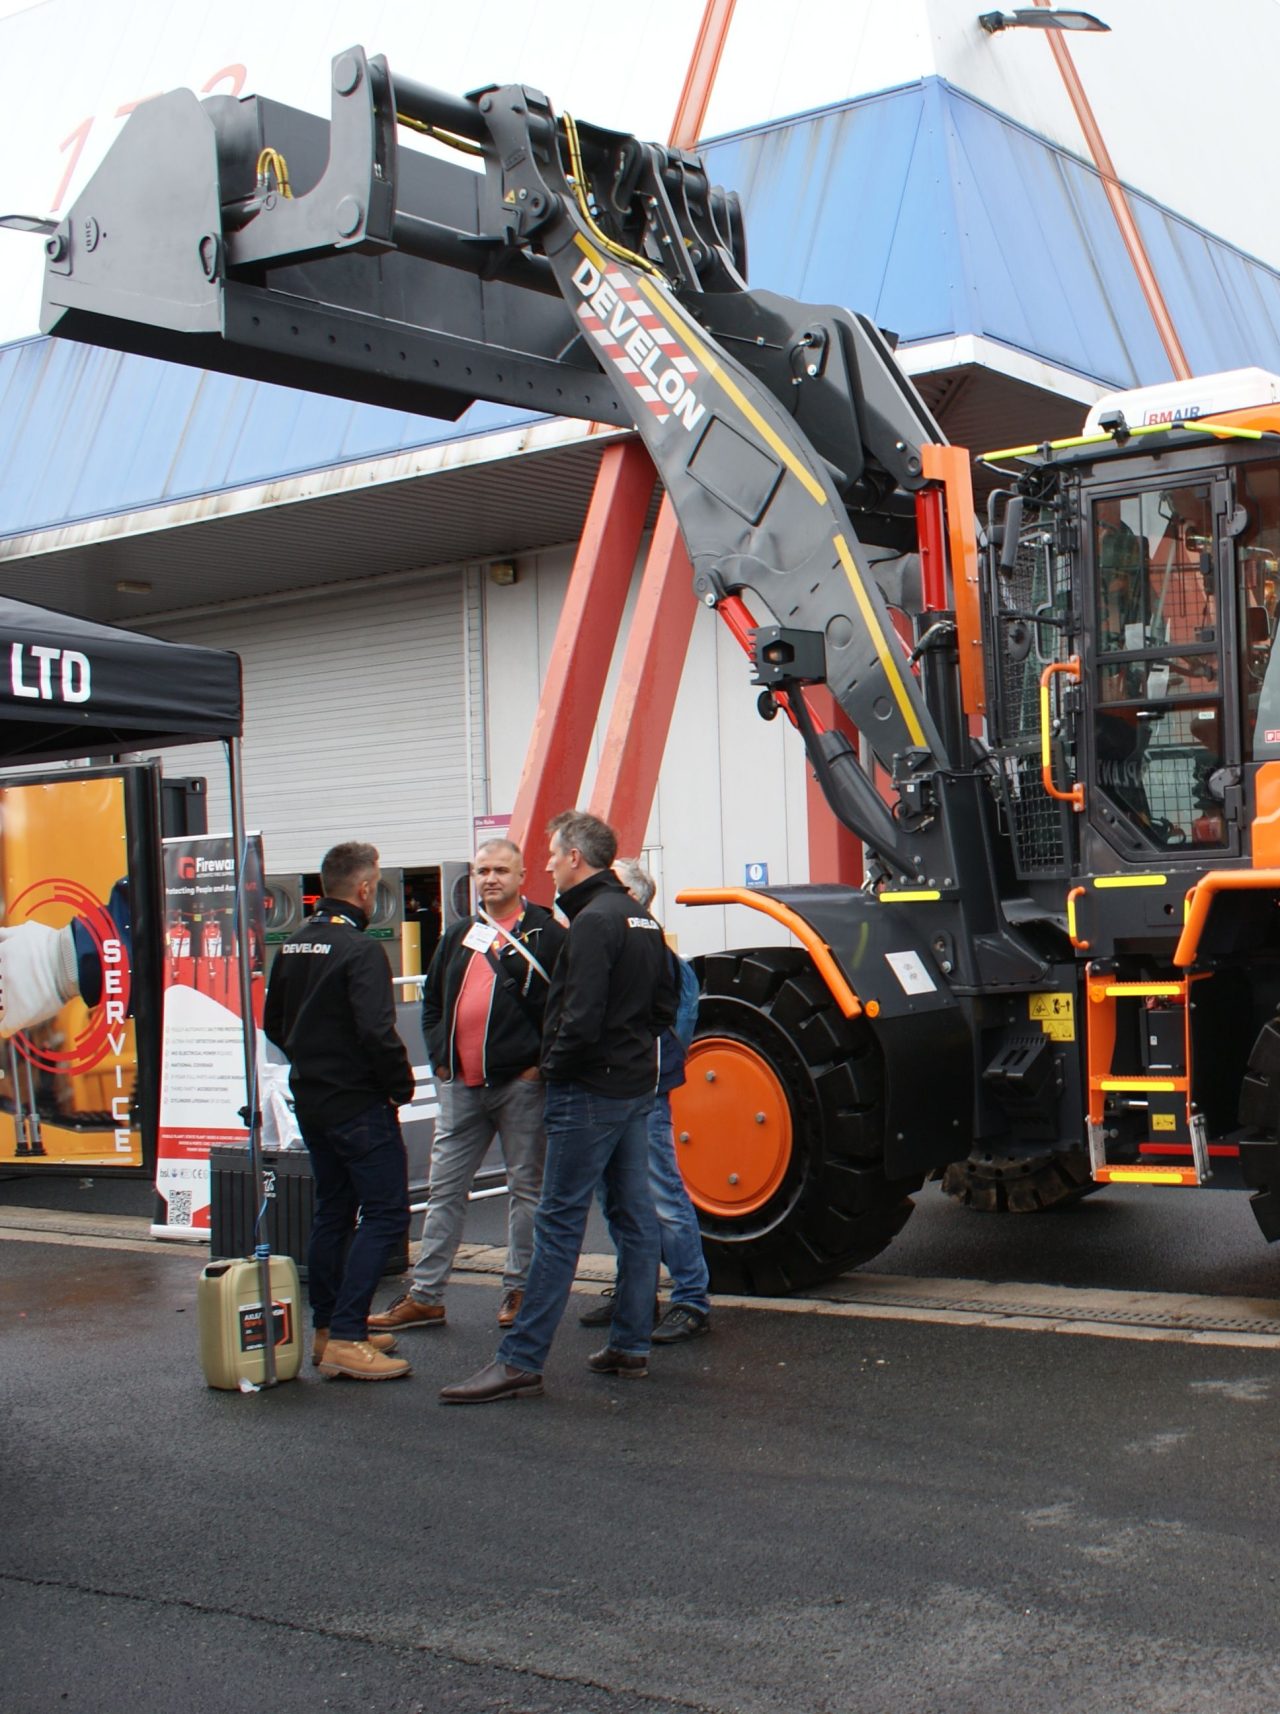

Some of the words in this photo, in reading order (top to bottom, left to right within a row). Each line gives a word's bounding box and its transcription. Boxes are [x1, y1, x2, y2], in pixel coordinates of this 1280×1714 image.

[571, 257, 706, 432] DEVELON
[1149, 406, 1200, 425] BMAIR
[11, 642, 91, 703] LTD
[282, 943, 332, 955] DEVELON
[103, 939, 132, 1152] SERVICE
